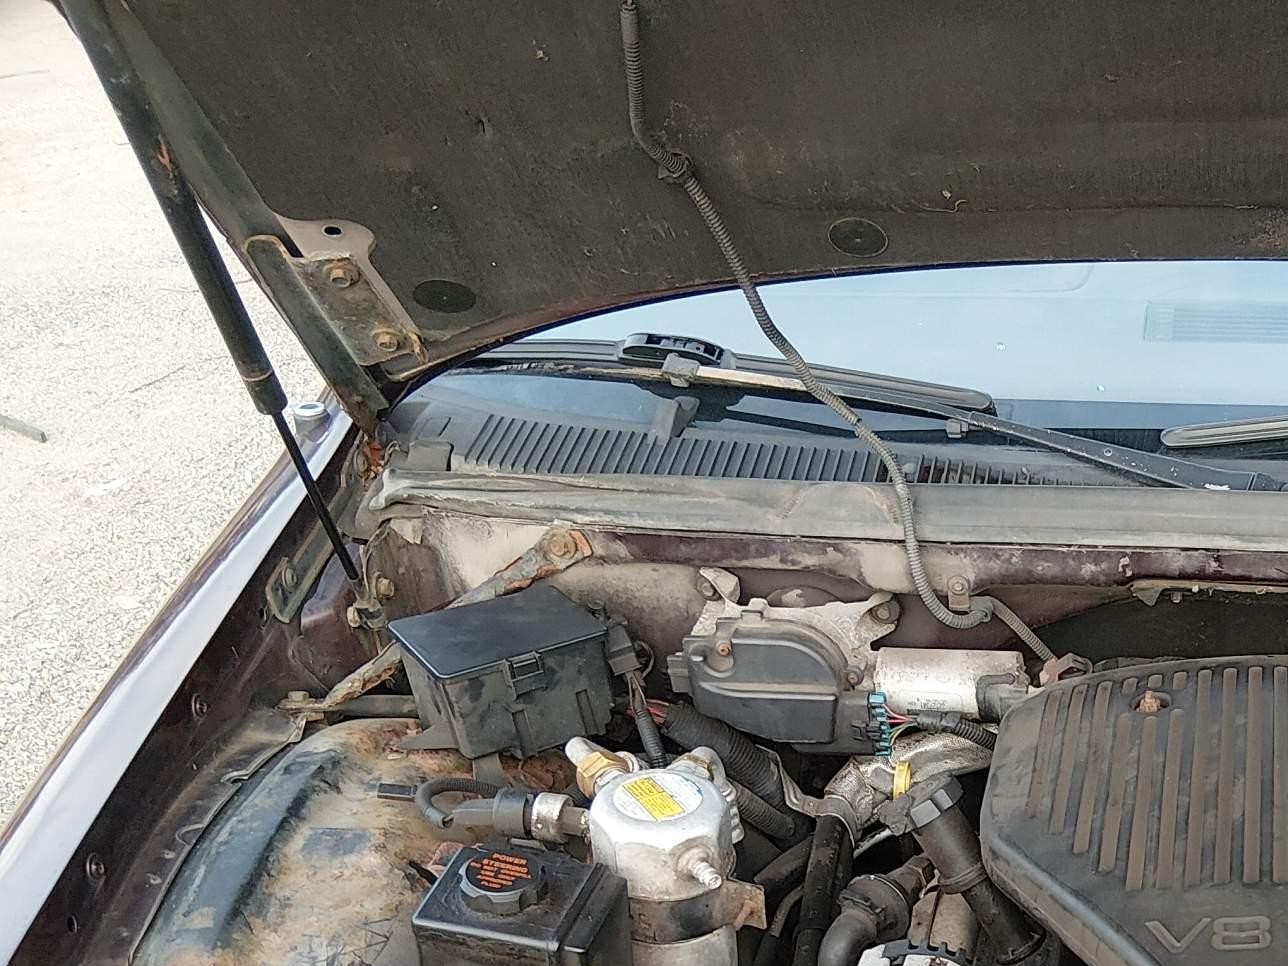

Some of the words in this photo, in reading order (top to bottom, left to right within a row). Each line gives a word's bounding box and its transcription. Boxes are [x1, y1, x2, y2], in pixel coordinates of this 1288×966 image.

[482, 858, 528, 873] STEERING
[492, 853, 528, 865] POWER
[1145, 916, 1272, 954] V8
